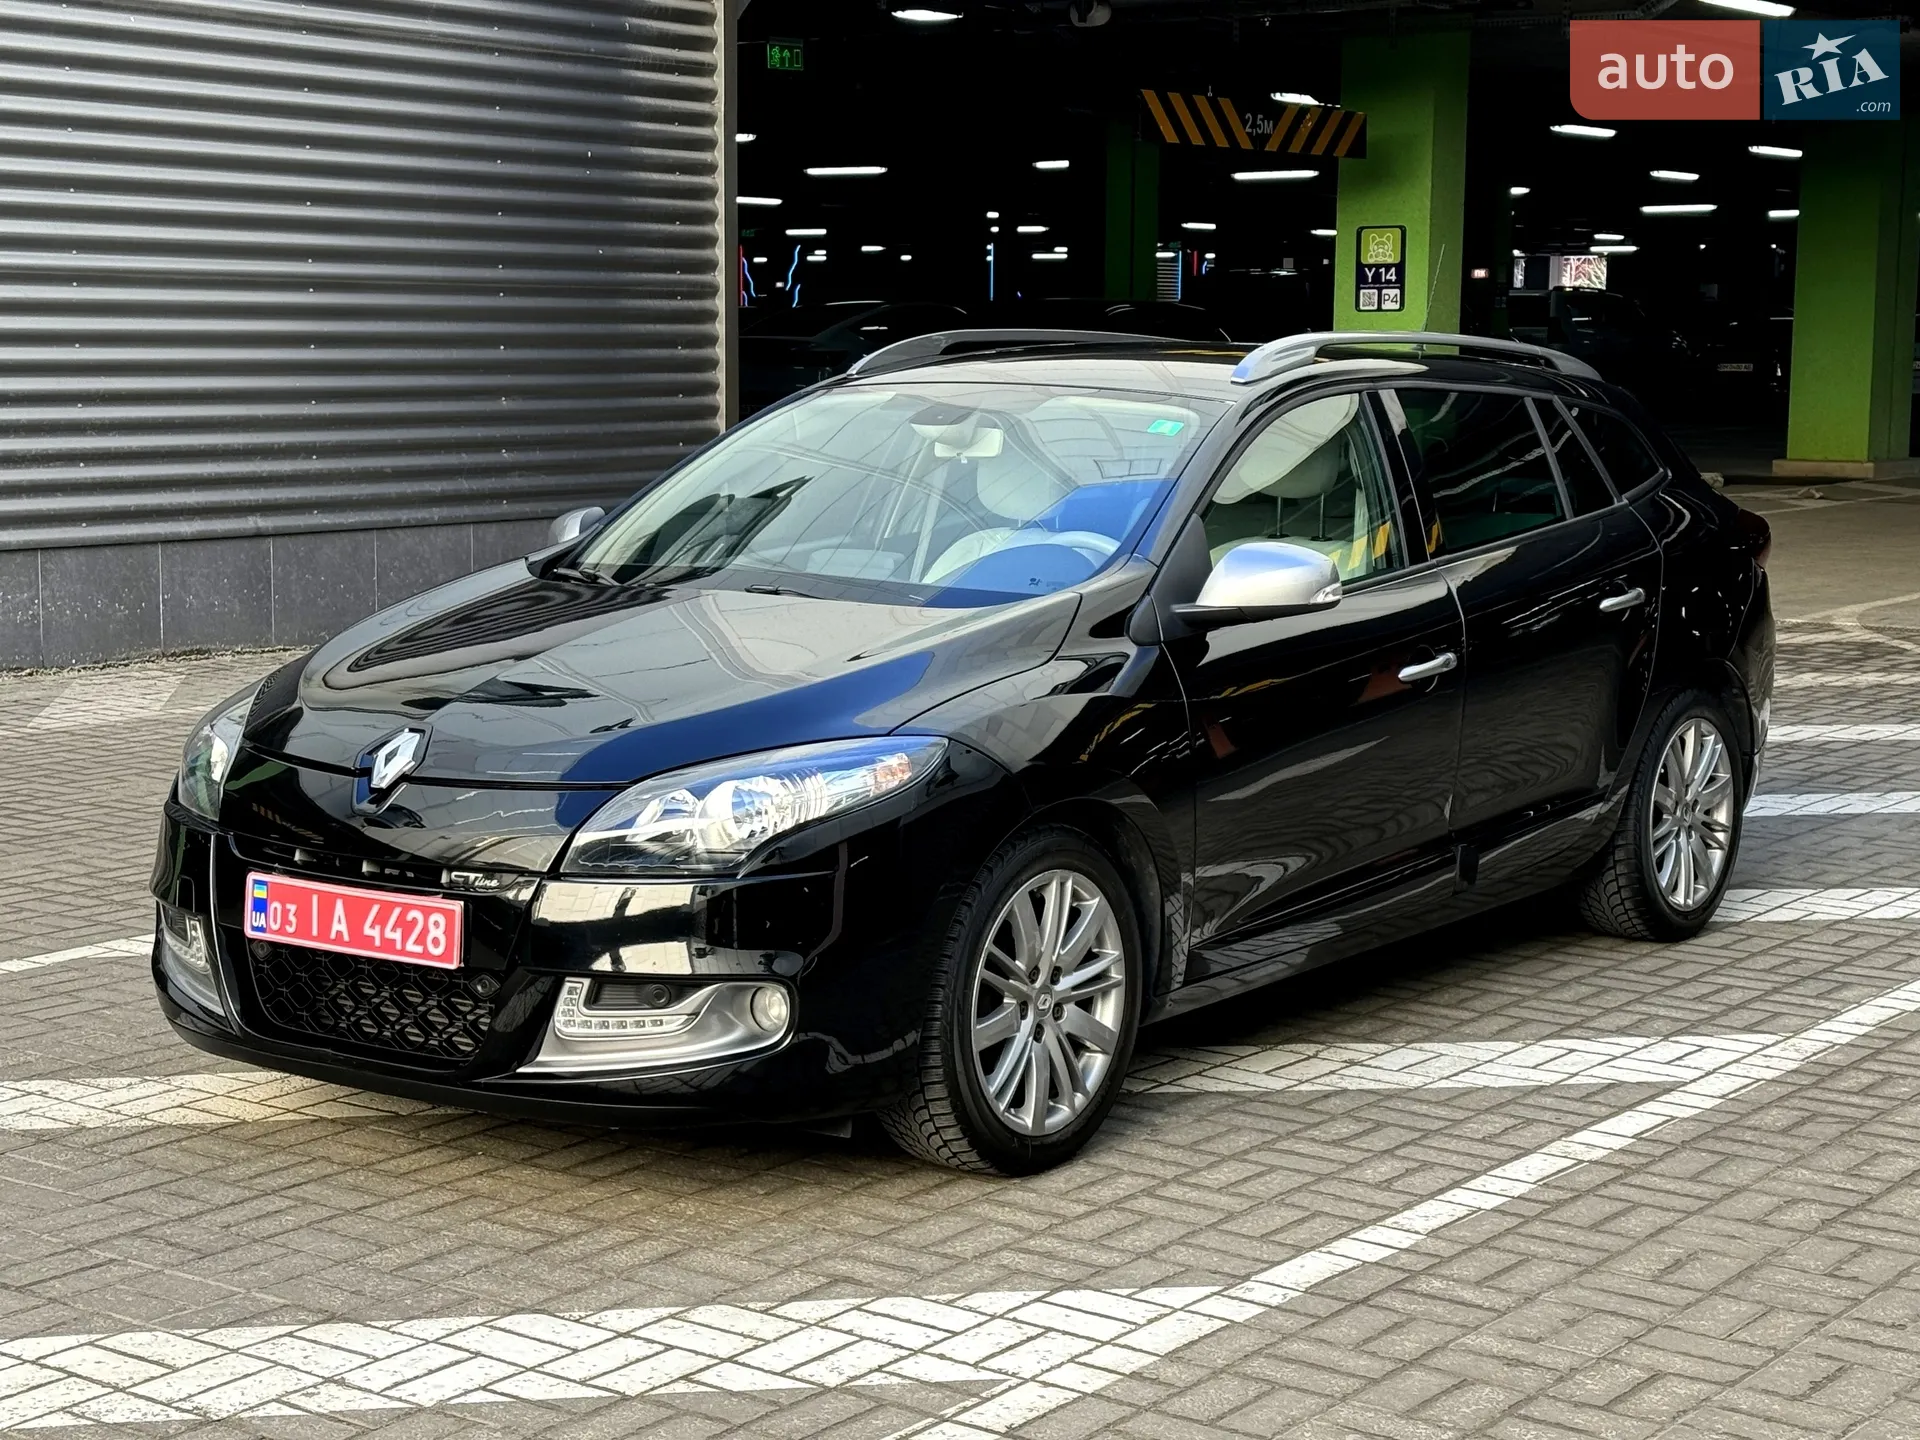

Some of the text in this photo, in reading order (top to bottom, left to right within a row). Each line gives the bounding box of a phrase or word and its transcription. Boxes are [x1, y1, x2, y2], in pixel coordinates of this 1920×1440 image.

[1364, 267, 1397, 283] Y 14
[1383, 293, 1399, 305] P4
[252, 911, 266, 928] UA
[269, 901, 297, 934] 03
[363, 903, 447, 957] 4428
